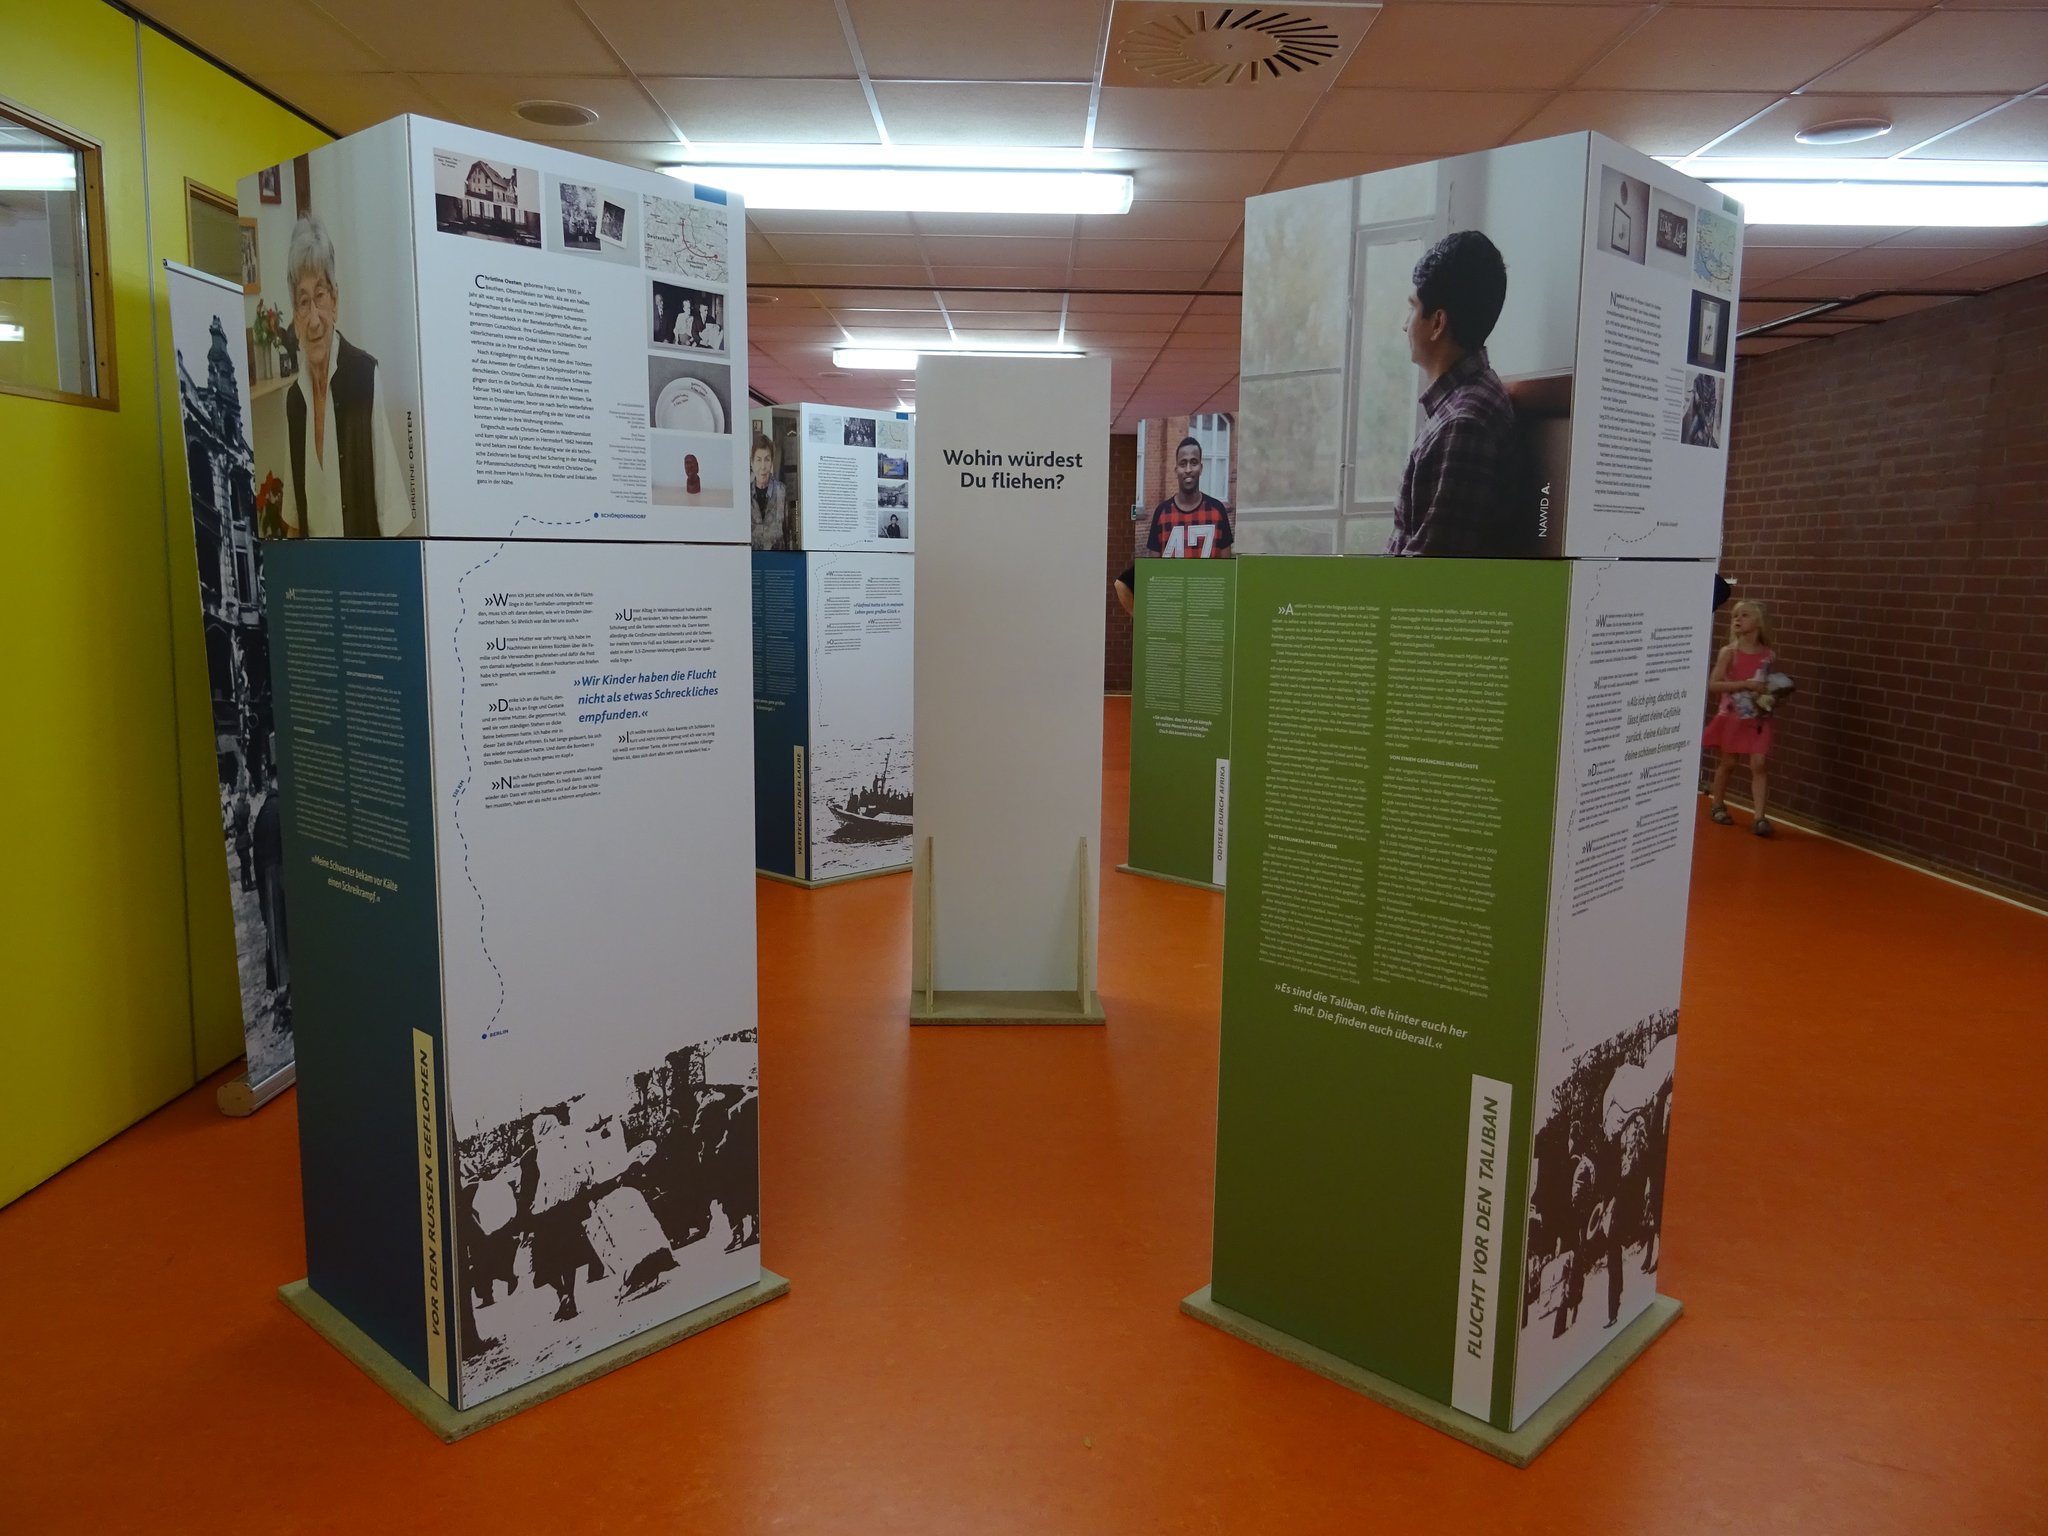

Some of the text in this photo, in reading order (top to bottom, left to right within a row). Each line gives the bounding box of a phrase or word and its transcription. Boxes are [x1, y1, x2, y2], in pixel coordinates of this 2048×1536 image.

[475, 274, 503, 289] Christine
[943, 449, 1083, 468] Wohin würdest
[961, 472, 1065, 489] Du fliehen?
[1538, 482, 1550, 537] NAWID A.
[1162, 525, 1216, 558] 47
[574, 669, 716, 686] »Wir Kinder haben die Flucht
[578, 686, 719, 704] nicht als etwas Schreckliches
[578, 709, 648, 724] empfunden.«
[798, 800, 802, 808] IN
[328, 877, 341, 888] einen
[330, 860, 355, 876] Schwester
[356, 868, 373, 883] bekam
[374, 878, 382, 886] vor
[383, 878, 398, 891] Kälte
[1274, 983, 1468, 1039] »Es sind die Taliban, die hinter euch her
[1293, 1004, 1443, 1049] sind. Die finden euch überall.«
[420, 1049, 440, 1336] VOR DEN RUSSEN GEFLOHEN
[1468, 1096, 1498, 1359] FLUCHT VOR DEN TALIBAN
